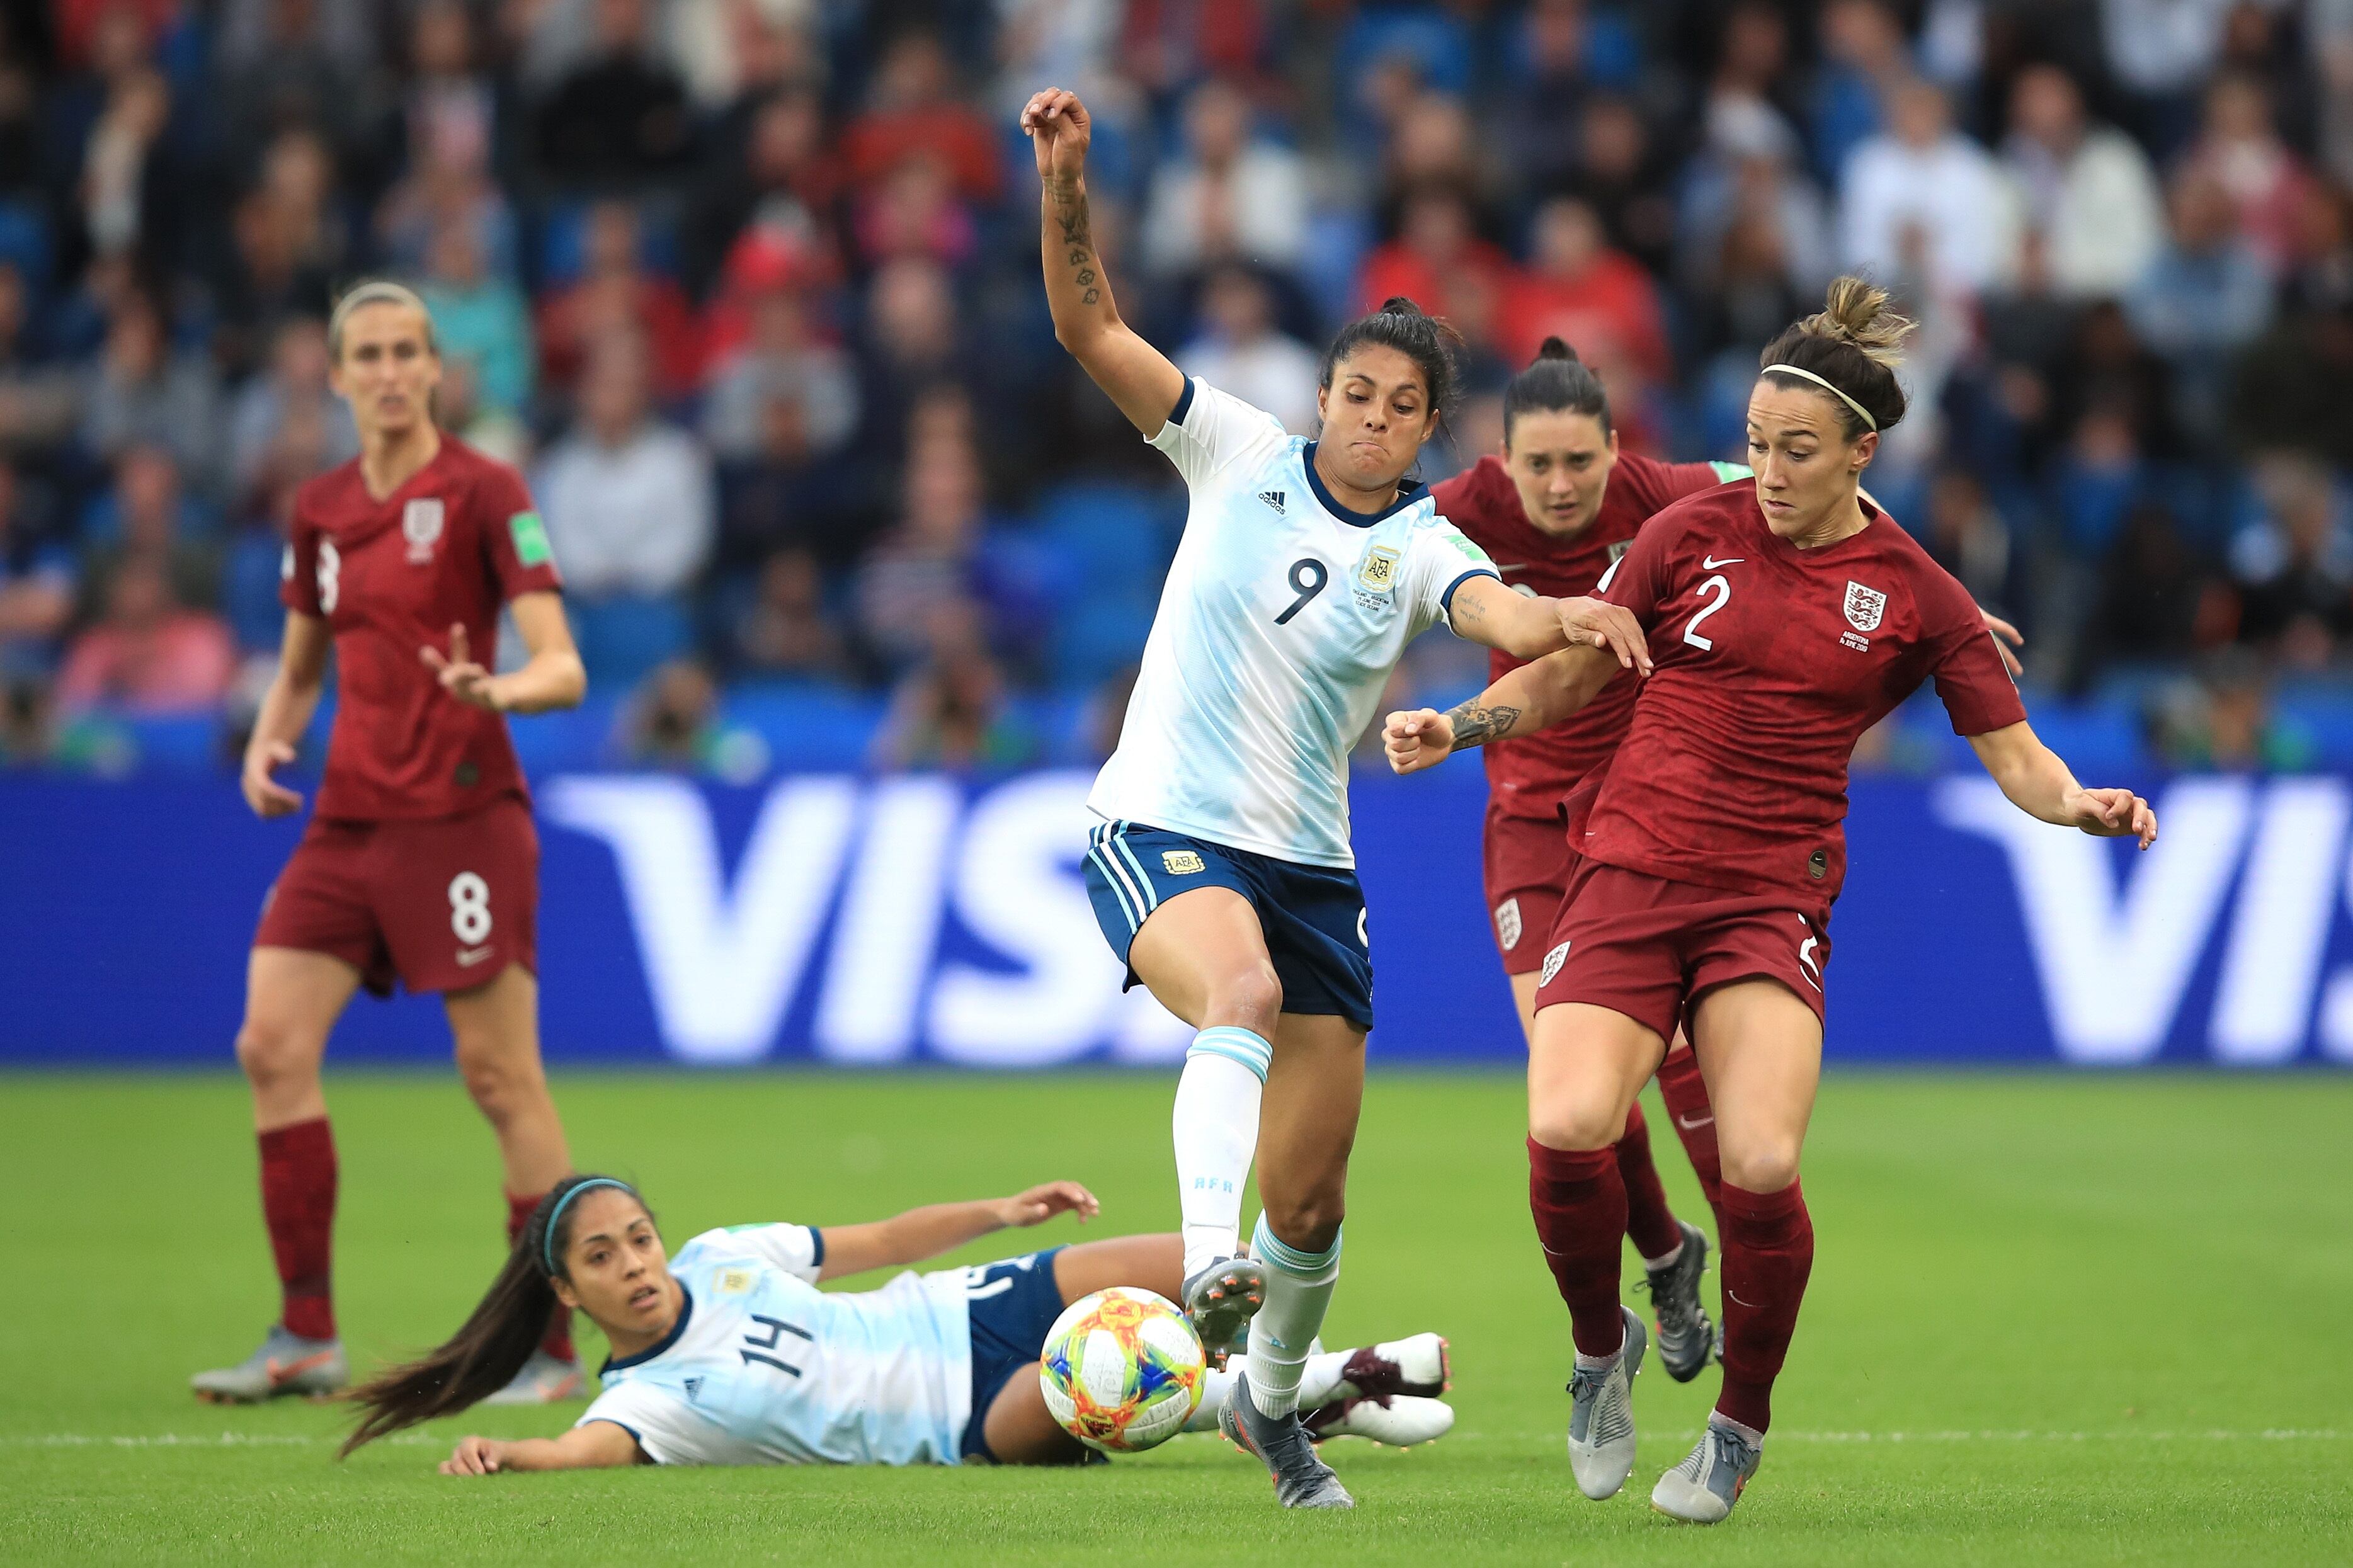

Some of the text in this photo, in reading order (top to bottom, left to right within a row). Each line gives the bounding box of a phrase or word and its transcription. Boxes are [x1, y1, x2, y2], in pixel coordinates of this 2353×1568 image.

[1258, 493, 1286, 515] adidas
[1273, 558, 1328, 625] 9
[1368, 556, 1389, 579] AFA
[1683, 574, 1731, 652] 2
[1842, 630, 1869, 645] ARGENTINA
[447, 870, 494, 945] 8
[543, 771, 1197, 1066] VIS
[1932, 773, 2353, 1065] VI
[739, 1313, 814, 1379] 14
